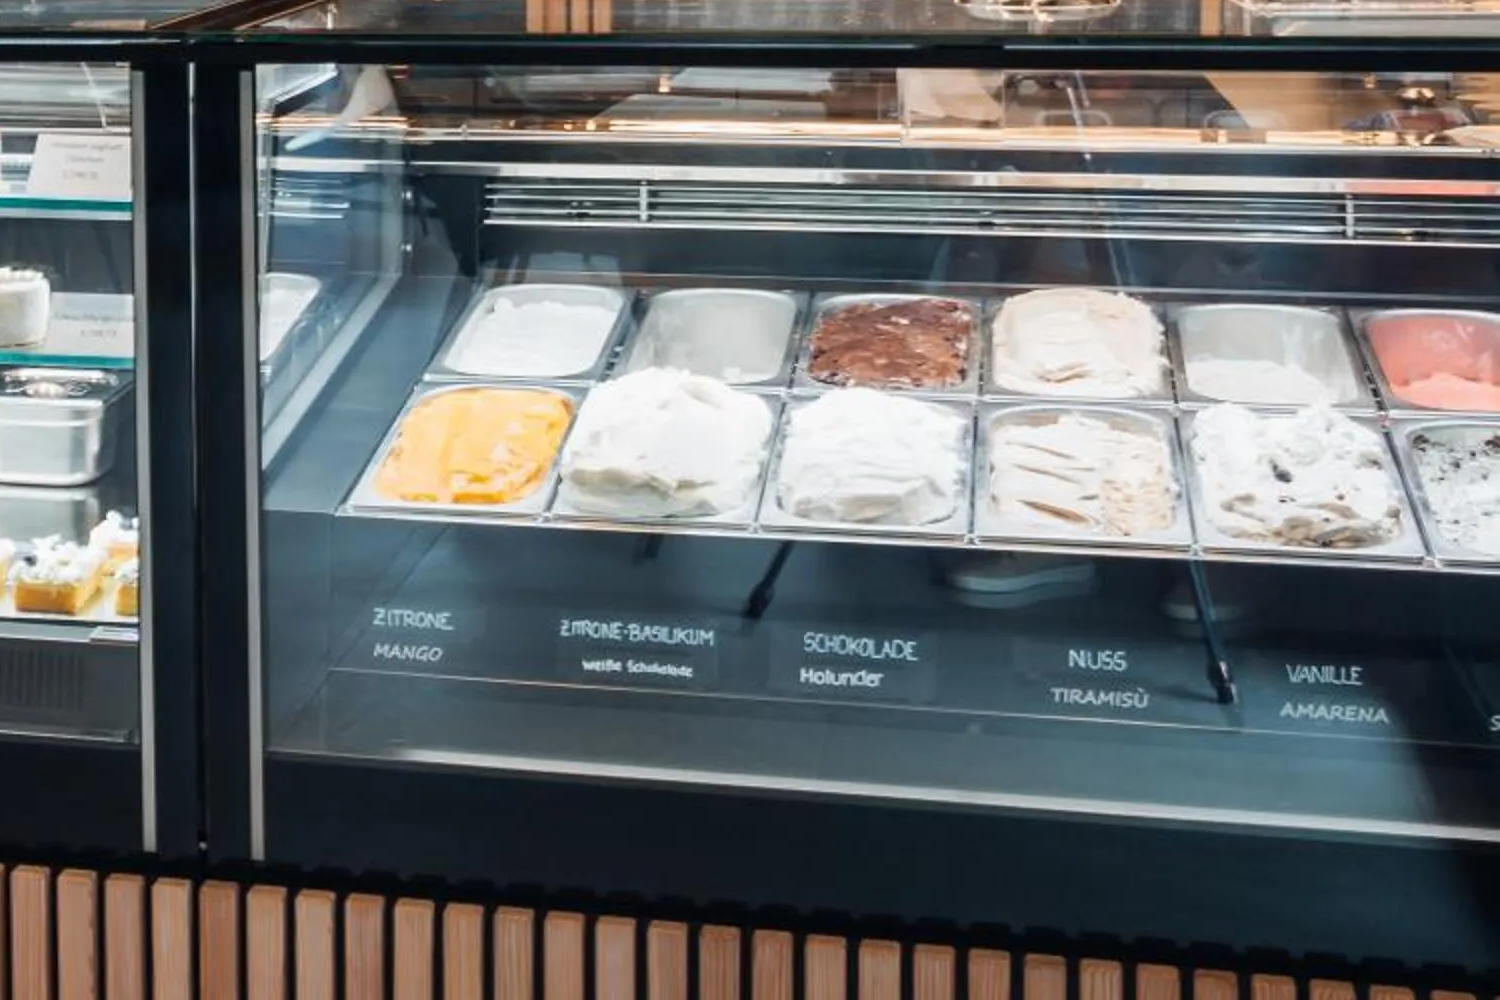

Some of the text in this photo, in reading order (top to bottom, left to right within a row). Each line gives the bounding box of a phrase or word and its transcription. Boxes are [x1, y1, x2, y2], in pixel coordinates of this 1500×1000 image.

[372, 607, 454, 631] ZITRONE
[372, 642, 444, 662] MANGO
[802, 631, 919, 661] SCHOKOLADE
[1067, 648, 1129, 672] NUSS
[799, 667, 885, 688] Holunder
[1284, 663, 1364, 686] VANILLE
[1049, 686, 1150, 710] TIRAMISÙ
[1279, 701, 1390, 725] AMARENA
